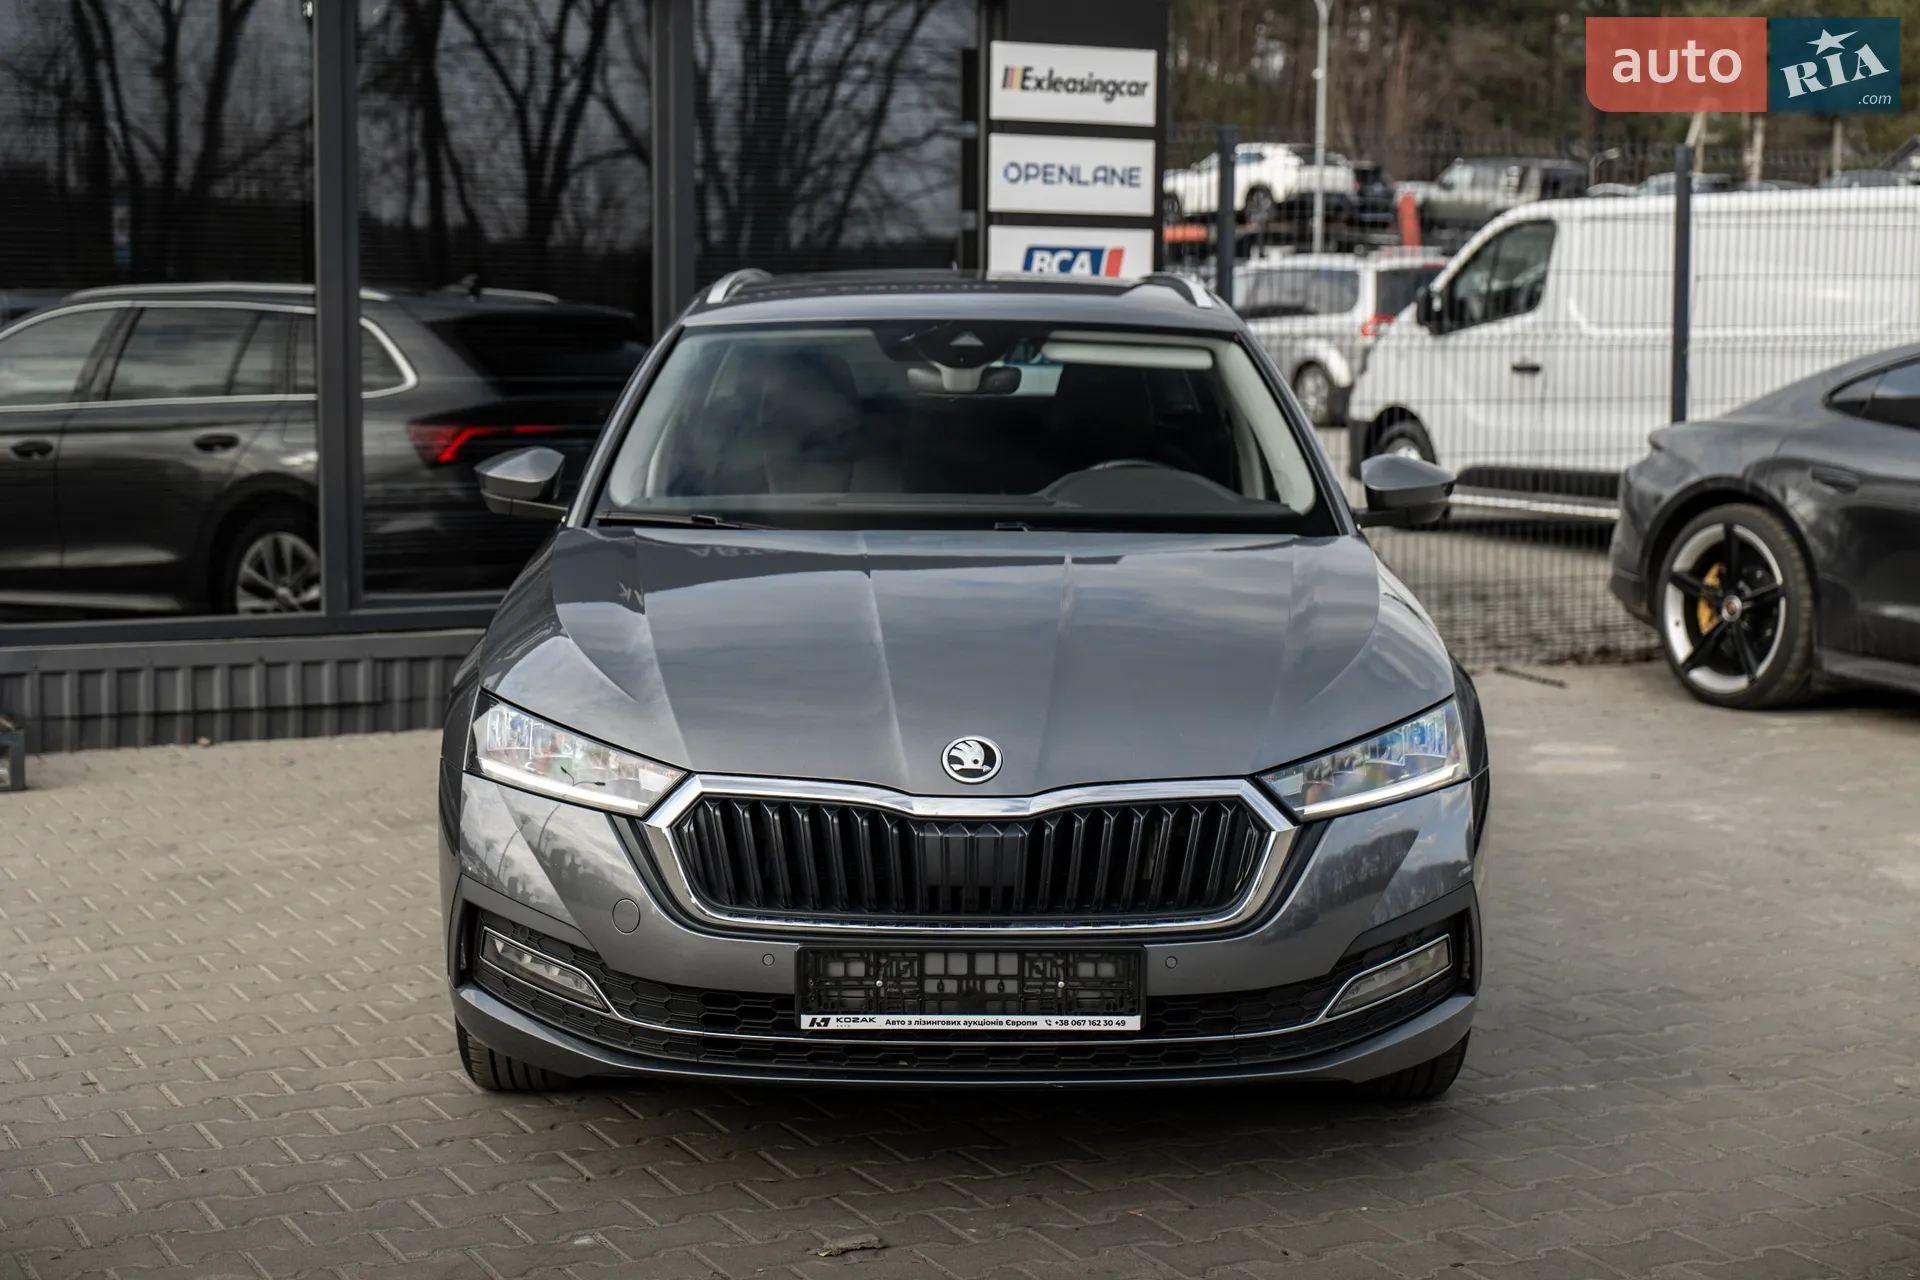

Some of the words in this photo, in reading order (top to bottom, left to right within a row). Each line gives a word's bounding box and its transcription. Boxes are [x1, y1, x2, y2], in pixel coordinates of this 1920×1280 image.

[1020, 66, 1149, 103] Exleasingcar
[1003, 161, 1142, 188] OPENLANE
[1031, 249, 1094, 275] BCA
[836, 1016, 877, 1024] KOZAK
[884, 1018, 906, 1026] Авто
[914, 1018, 962, 1026] лізингових
[963, 1018, 1004, 1028] аукціонів
[1005, 1018, 1038, 1028] Європи
[1054, 1019, 1070, 1027] +38
[1071, 1019, 1087, 1027] 067
[1088, 1019, 1102, 1027] 162
[1103, 1019, 1114, 1027] 30
[1115, 1019, 1127, 1027] 49
